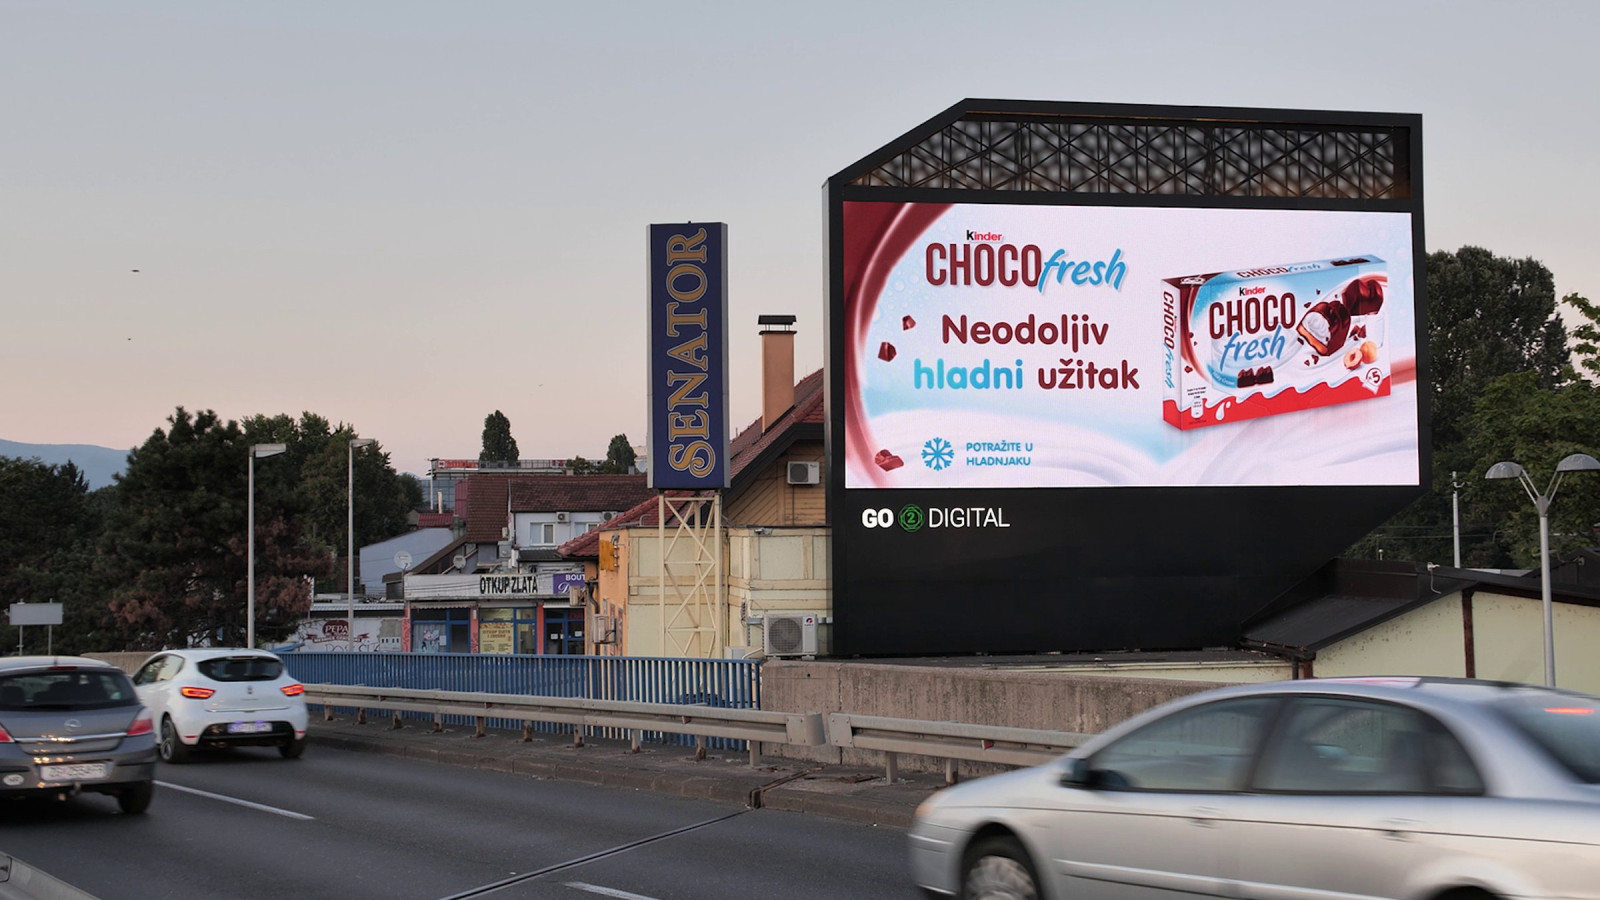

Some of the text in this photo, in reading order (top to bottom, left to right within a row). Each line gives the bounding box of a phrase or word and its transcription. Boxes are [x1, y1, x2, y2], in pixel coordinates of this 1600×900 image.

[966, 229, 1003, 241] kinder
[1239, 286, 1267, 297] kinder
[1209, 292, 1297, 340] CHOCO
[942, 313, 1109, 353] Neodoljiv
[666, 228, 716, 478] SENATOR
[1219, 325, 1286, 371] fresh
[914, 358, 1140, 390] hladni užitak
[966, 440, 1034, 452] POTRAŽITE U
[966, 457, 1031, 466] HLADNJAKU
[861, 508, 895, 529] GO
[928, 507, 1011, 529] DIGITAL
[480, 577, 511, 594] OTKUP
[511, 575, 538, 594] ZLATA
[325, 624, 348, 633] PEPA
